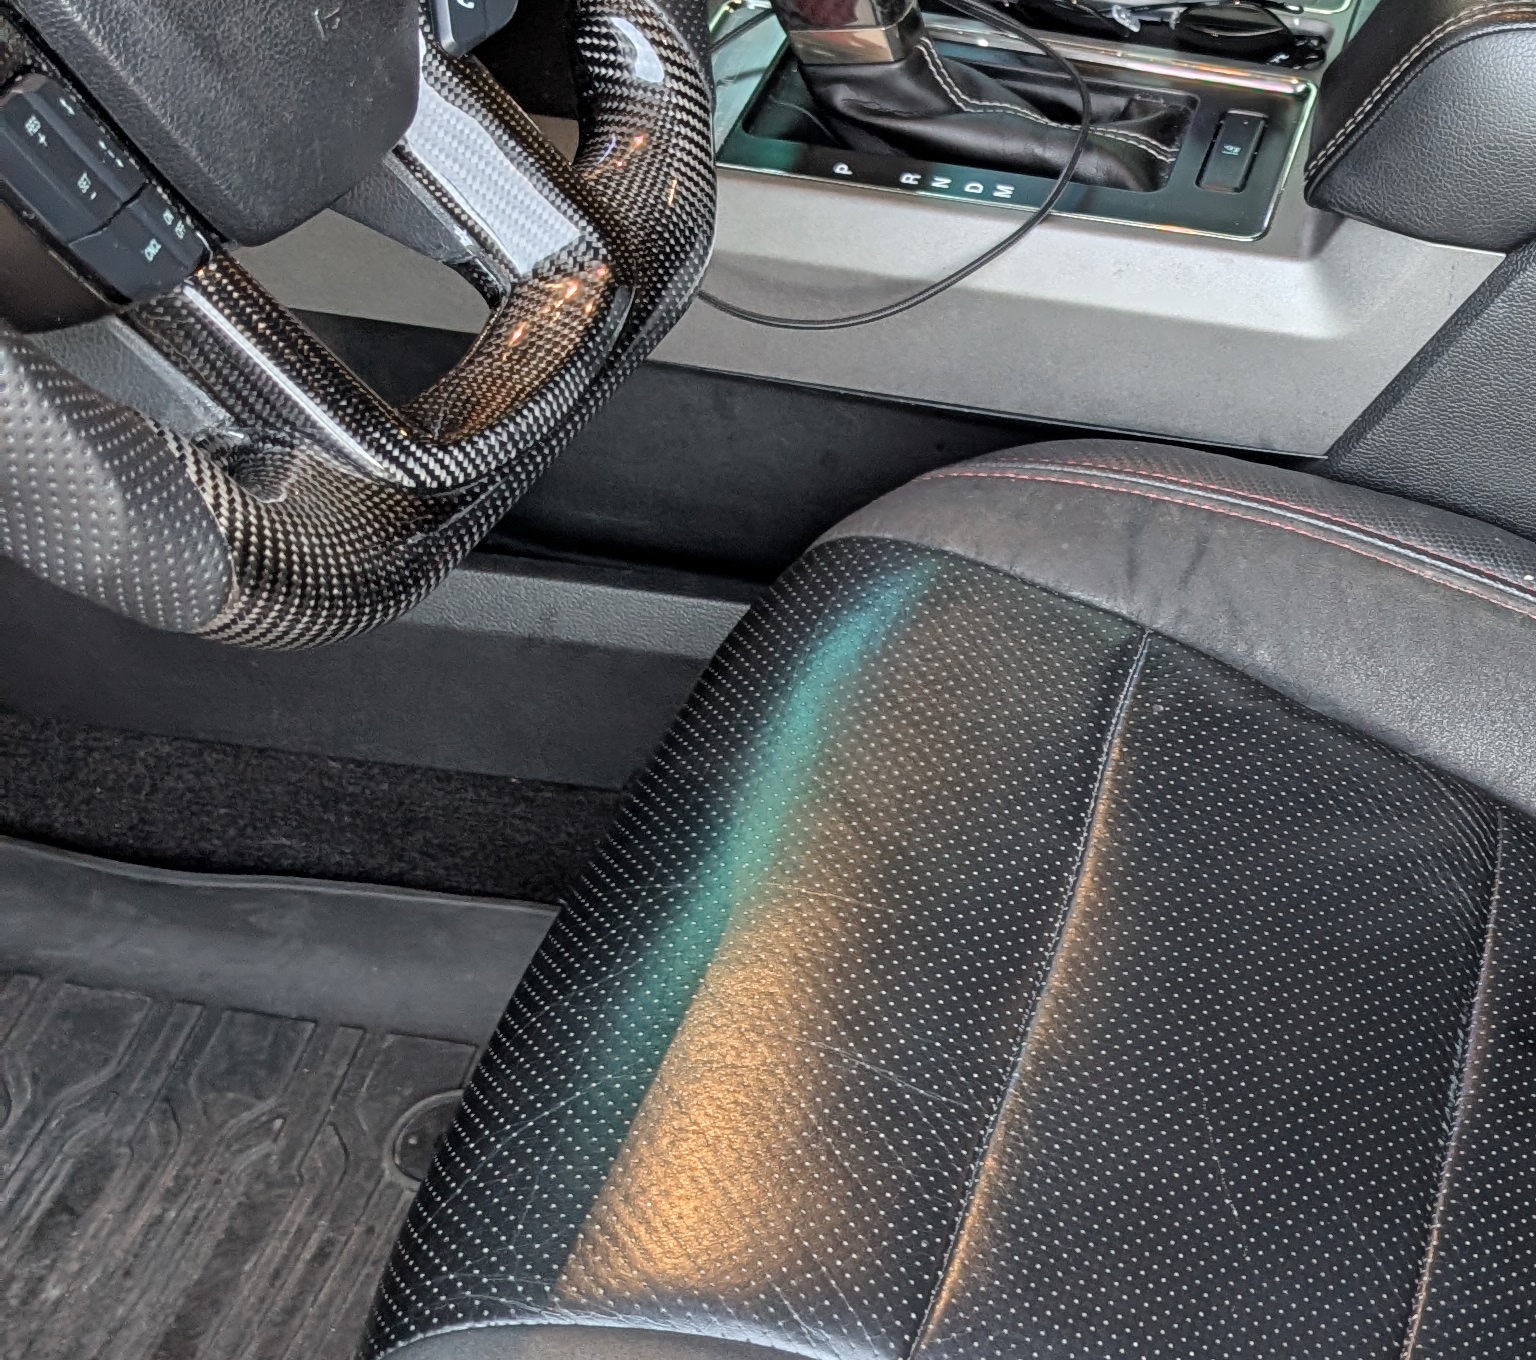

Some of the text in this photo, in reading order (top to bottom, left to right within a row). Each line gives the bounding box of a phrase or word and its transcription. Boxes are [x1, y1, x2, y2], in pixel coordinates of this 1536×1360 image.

[833, 161, 1016, 199] P R N D M
